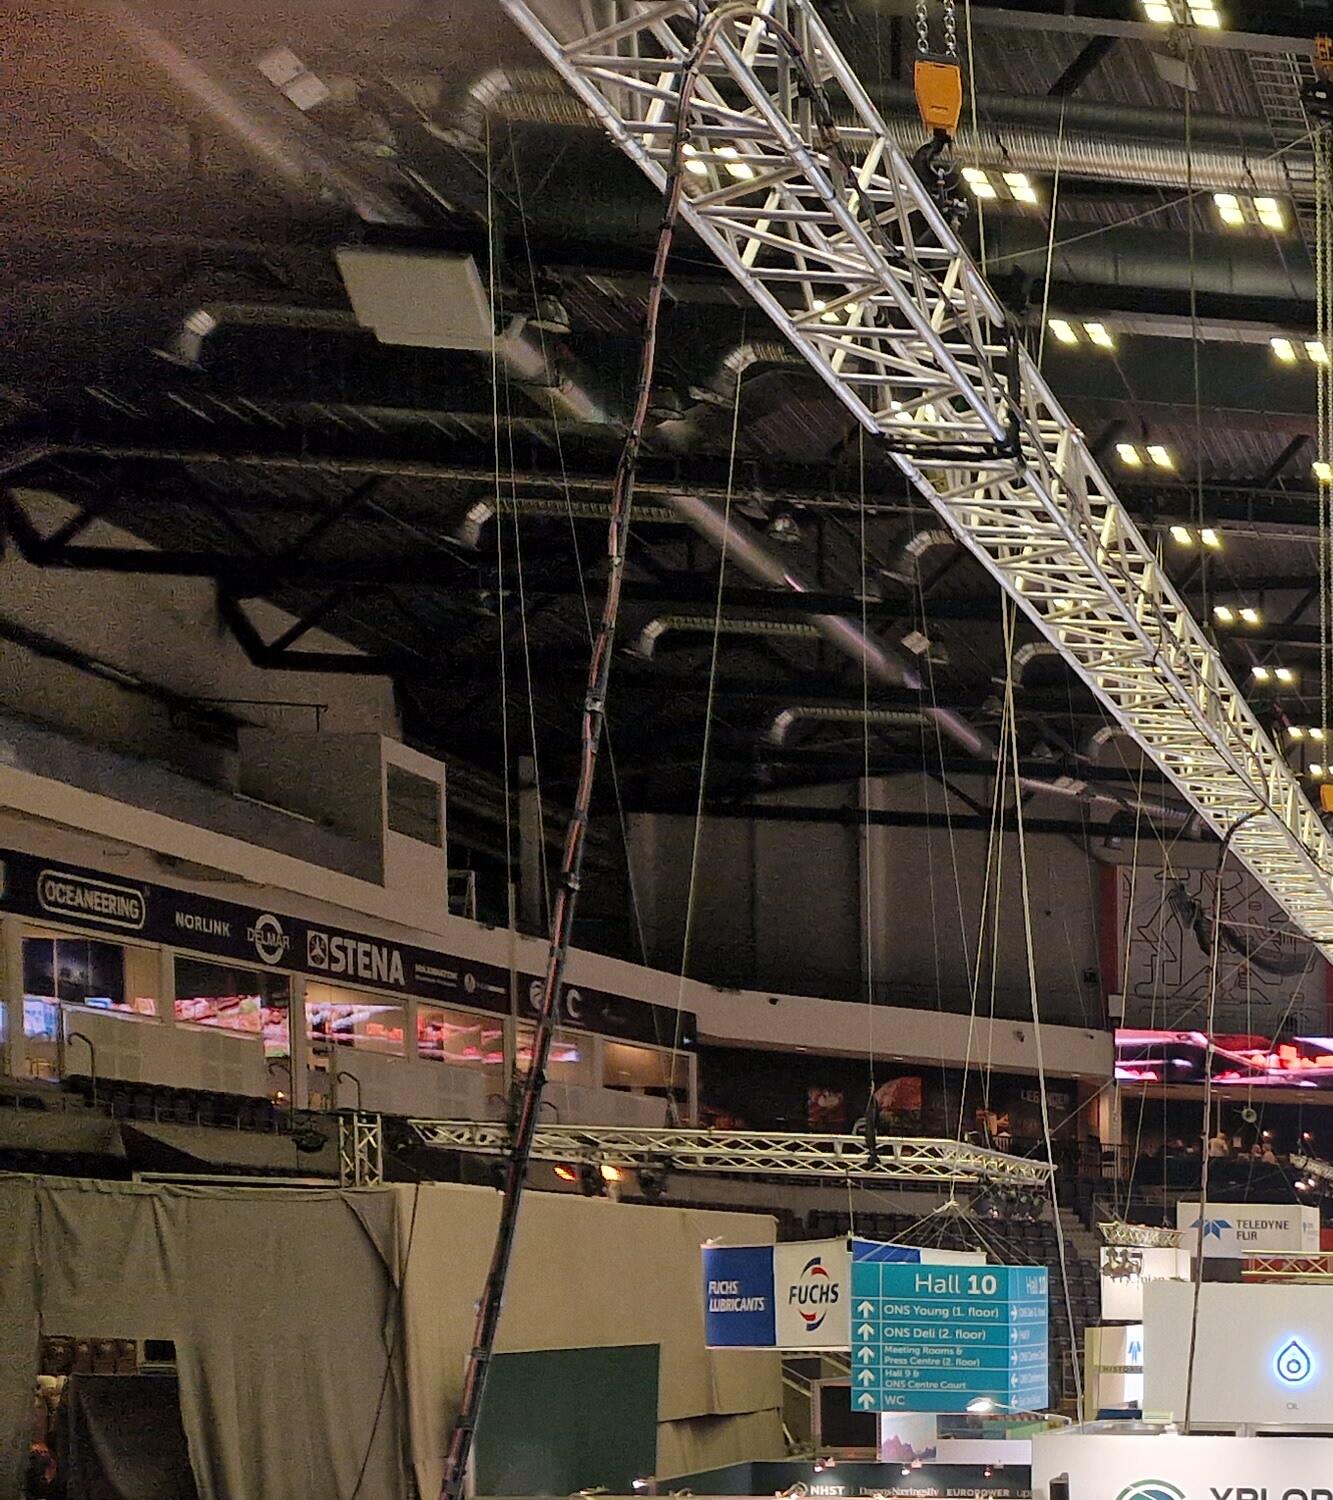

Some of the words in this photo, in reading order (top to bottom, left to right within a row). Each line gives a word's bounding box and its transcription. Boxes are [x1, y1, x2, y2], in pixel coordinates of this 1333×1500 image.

[44, 878, 140, 919] OCEANEERING
[175, 911, 231, 937] NORLINK
[247, 928, 290, 949] DELMAR
[330, 936, 406, 986] STENA
[1236, 1219, 1290, 1231] TELEDYNE
[1236, 1231, 1258, 1241] FLIR
[708, 1280, 739, 1295] FUCHS
[915, 1273, 961, 1294] Hall
[967, 1274, 997, 1295] 10
[788, 1281, 840, 1305] FUCHS
[708, 1296, 765, 1313] LUBRICANTS
[884, 1305, 911, 1315] ONS
[913, 1305, 949, 1318] Young
[968, 1305, 999, 1318] floor)
[884, 1327, 911, 1338] ONS
[913, 1328, 936, 1338] Deli
[955, 1329, 986, 1341] floor)
[884, 1346, 921, 1356] Meeting
[923, 1347, 954, 1355] Rooms
[884, 1357, 908, 1365] Press
[909, 1358, 940, 1366] Centre
[907, 1381, 938, 1389] Centre
[884, 1395, 906, 1405] WC
[810, 1486, 846, 1495] NHST
[946, 1488, 1010, 1497] EUROPOWER
